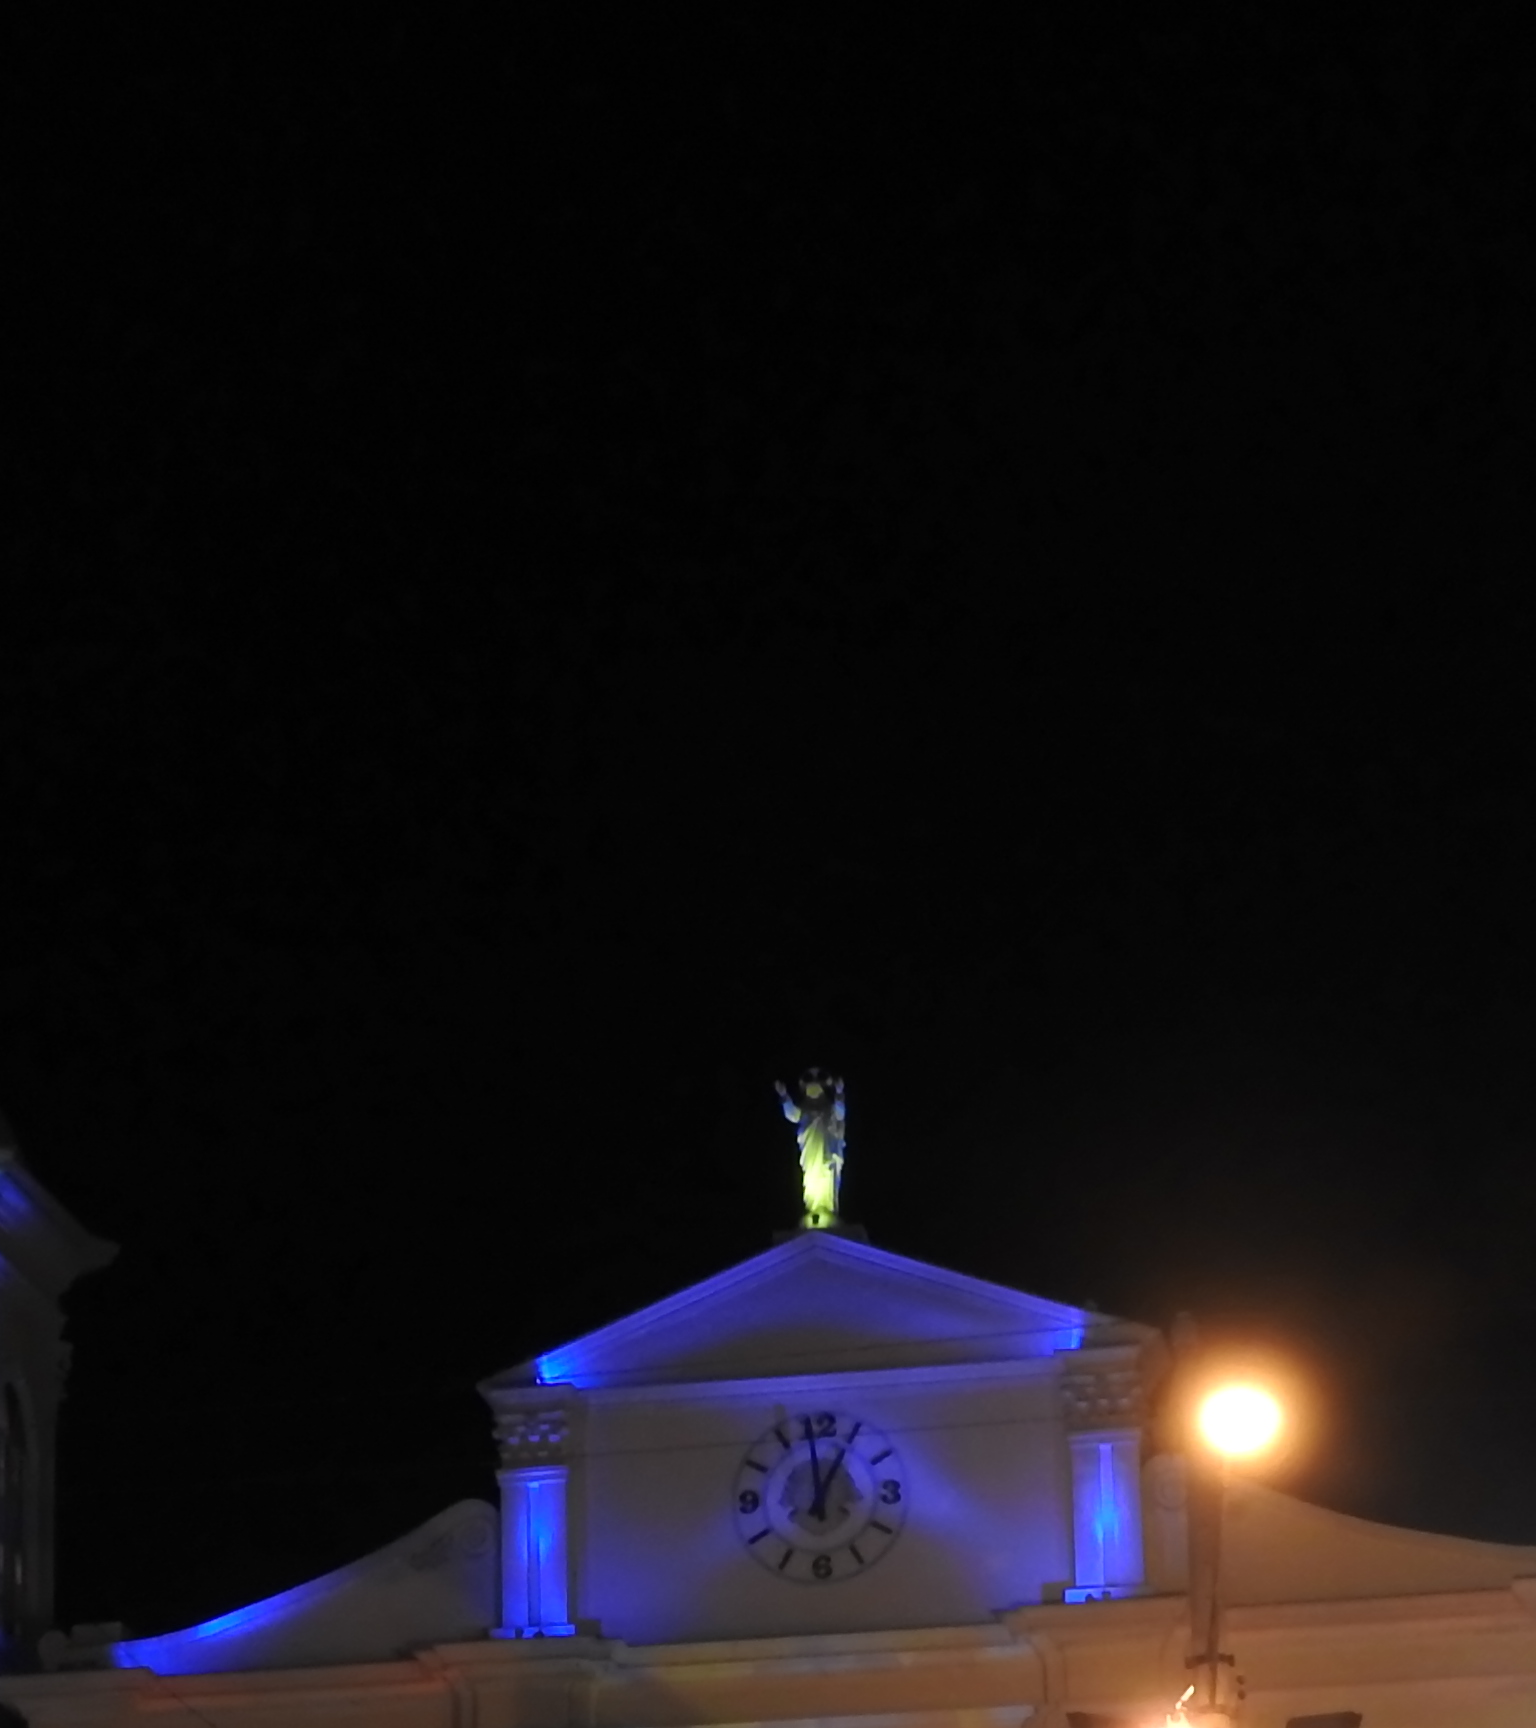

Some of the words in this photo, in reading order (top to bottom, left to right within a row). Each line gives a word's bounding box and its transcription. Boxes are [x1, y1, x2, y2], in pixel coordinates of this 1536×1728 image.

[739, 1490, 760, 1514] 9
[880, 1479, 901, 1504] 3
[812, 1555, 833, 1579] 6
